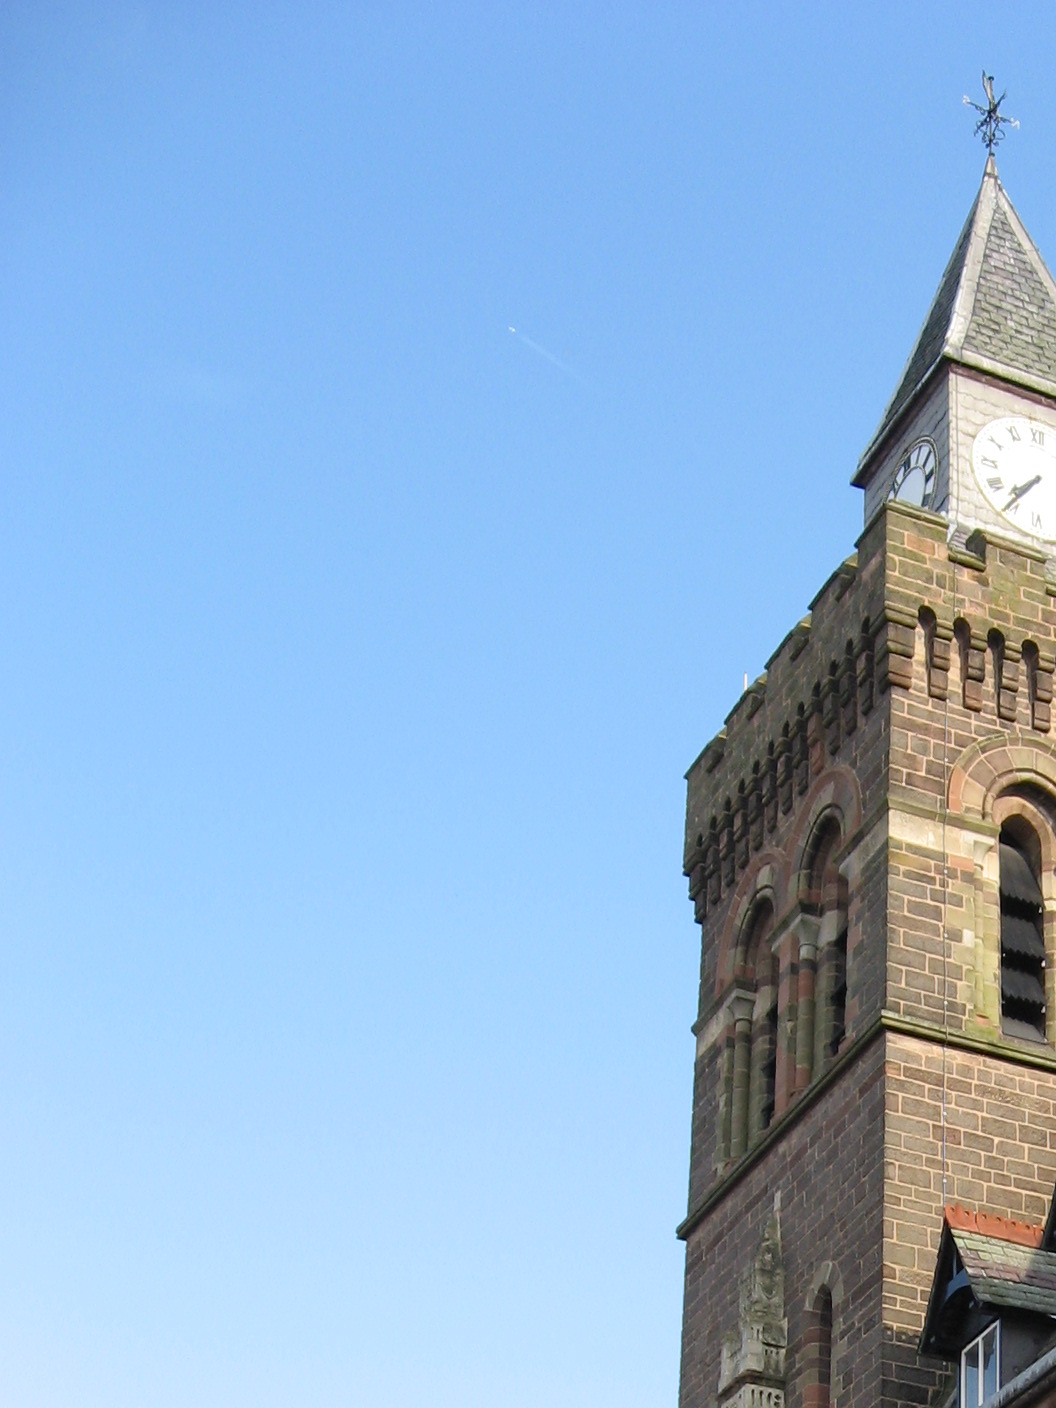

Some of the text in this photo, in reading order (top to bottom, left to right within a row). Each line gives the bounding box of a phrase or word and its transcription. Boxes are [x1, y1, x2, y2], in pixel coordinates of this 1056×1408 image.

[1005, 426, 1022, 442] XI
[1030, 427, 1045, 446] XII
[988, 435, 1004, 451] X
